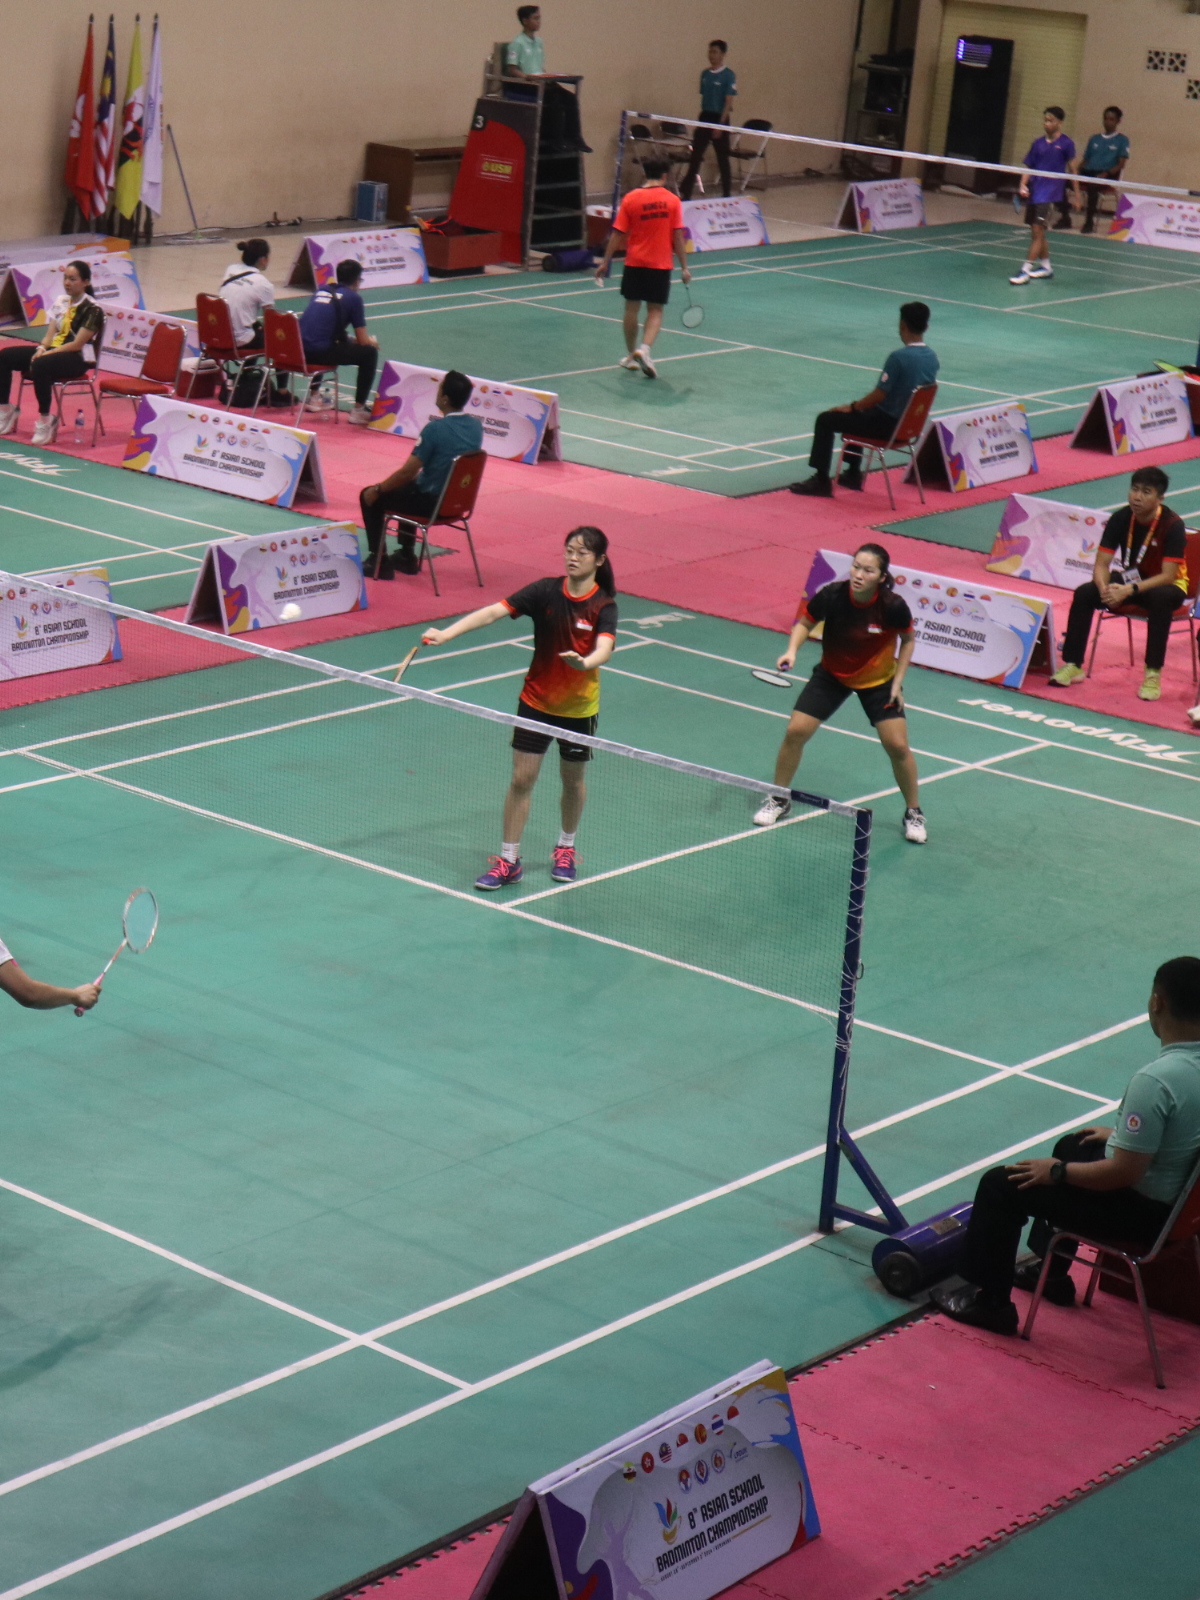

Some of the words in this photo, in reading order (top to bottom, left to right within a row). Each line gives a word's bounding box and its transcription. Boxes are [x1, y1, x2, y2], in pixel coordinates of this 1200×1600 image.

[475, 115, 484, 129] 3
[922, 632, 984, 653] CHAMPIONSHIP
[924, 620, 952, 634] ASIAN
[952, 627, 987, 643] SCHOOL
[957, 698, 1173, 752] Flypower
[700, 1493, 730, 1523] ASIAN
[729, 1473, 765, 1506] SCHOOL
[655, 1533, 708, 1573] BADMINTON
[707, 1496, 769, 1543] CHAMPIONSHIP
